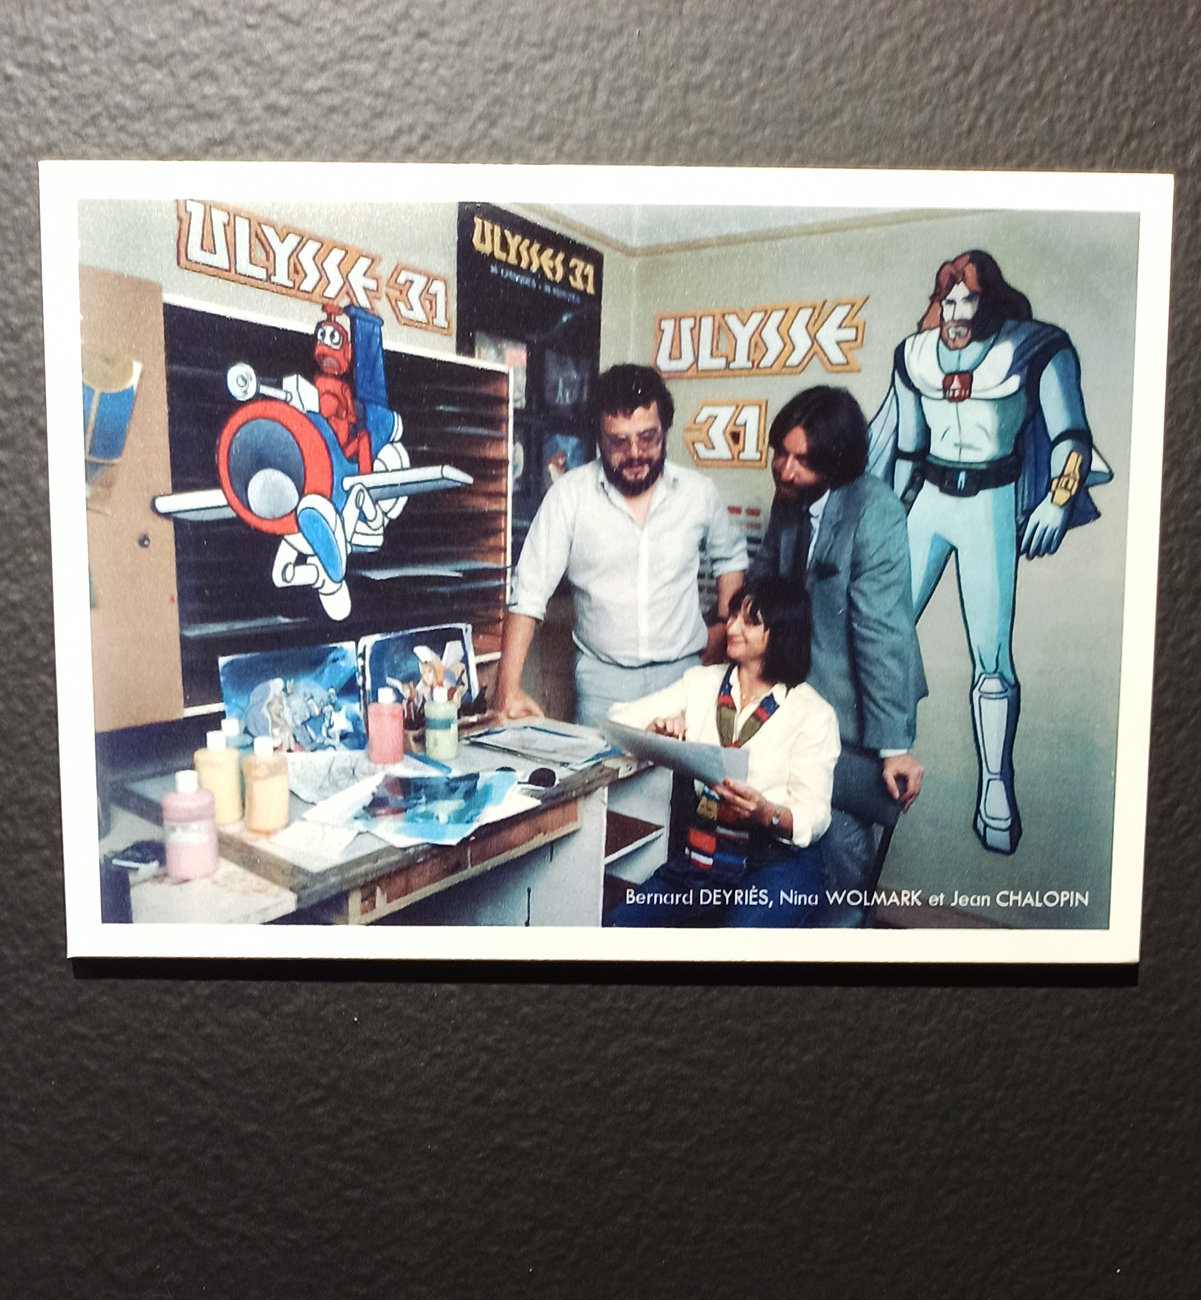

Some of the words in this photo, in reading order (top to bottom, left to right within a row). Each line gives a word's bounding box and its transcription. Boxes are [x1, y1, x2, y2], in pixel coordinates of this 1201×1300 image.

[184, 199, 380, 308] ULYSSE
[396, 268, 452, 330] 31
[472, 216, 562, 282] ULYSSES
[568, 257, 597, 296] 31
[655, 303, 858, 372] ULYSSE
[694, 404, 761, 461] 31
[626, 888, 694, 905] Bernard
[779, 889, 819, 905] Nina
[825, 889, 922, 906] WOLMARK
[928, 892, 945, 907] et
[950, 890, 991, 907] Jean
[996, 890, 1089, 907] CHALOPIN
